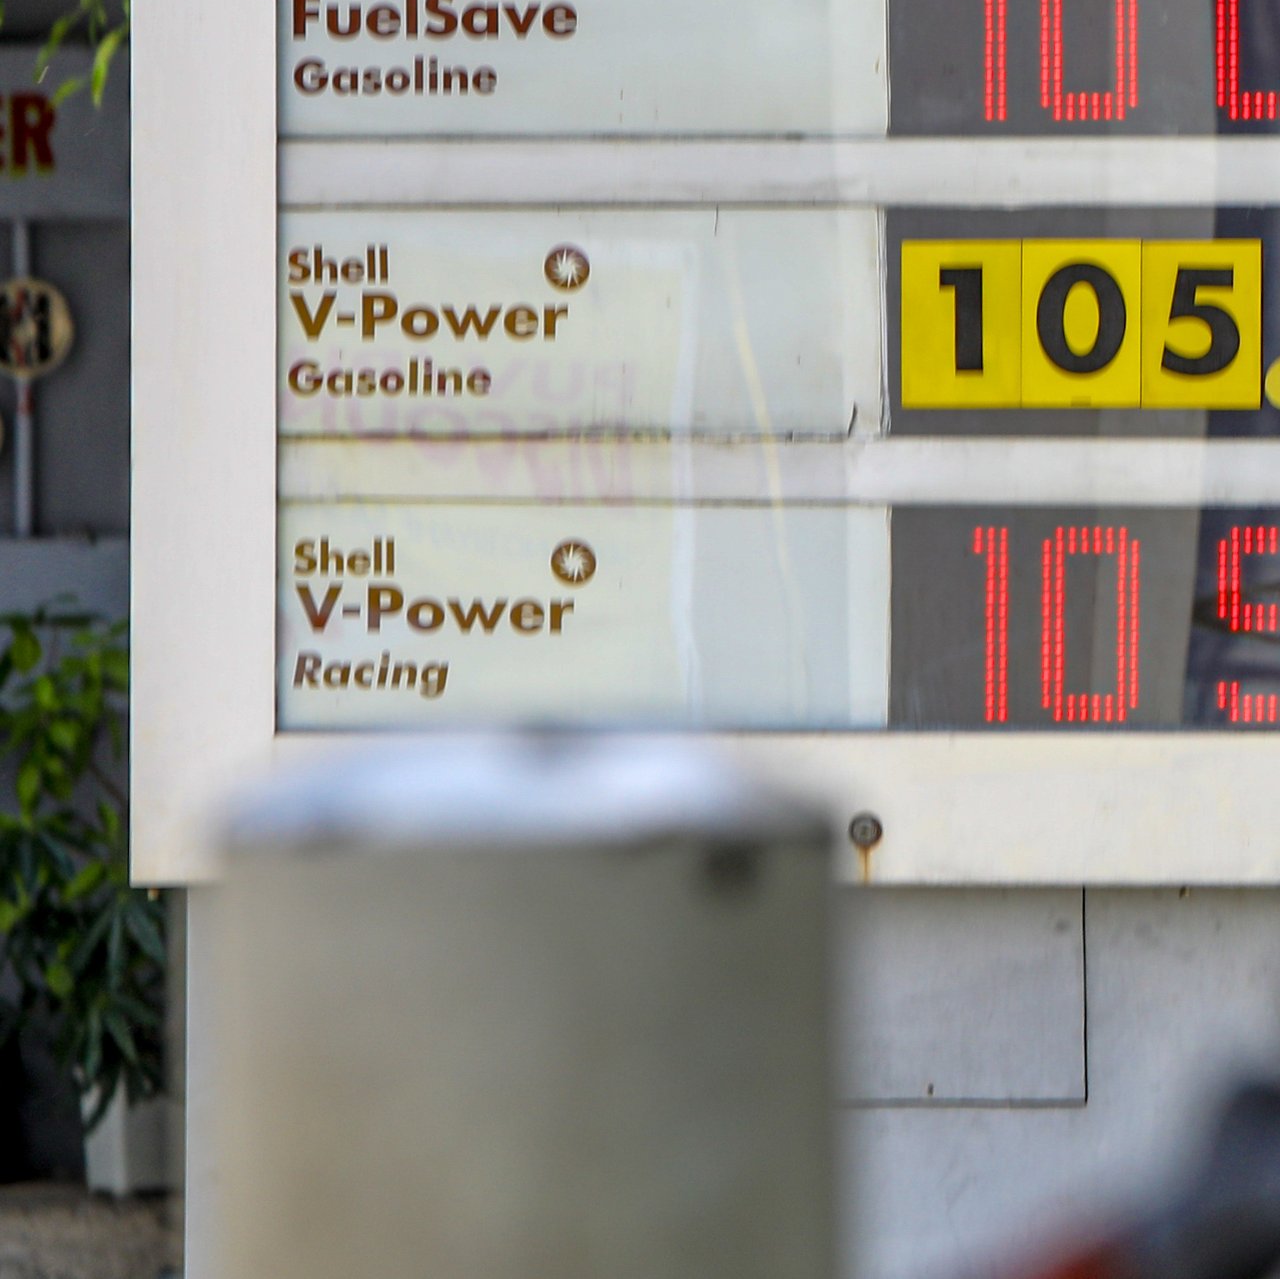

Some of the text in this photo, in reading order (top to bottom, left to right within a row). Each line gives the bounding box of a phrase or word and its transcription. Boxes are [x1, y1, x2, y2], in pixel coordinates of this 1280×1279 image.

[293, 57, 498, 96] Gasoline
[287, 243, 389, 285] Shell
[288, 291, 569, 342] V-Power
[287, 358, 492, 397] Gasoline
[293, 536, 396, 577] Shell
[295, 583, 575, 635] V-Power
[292, 649, 450, 700] Racing
